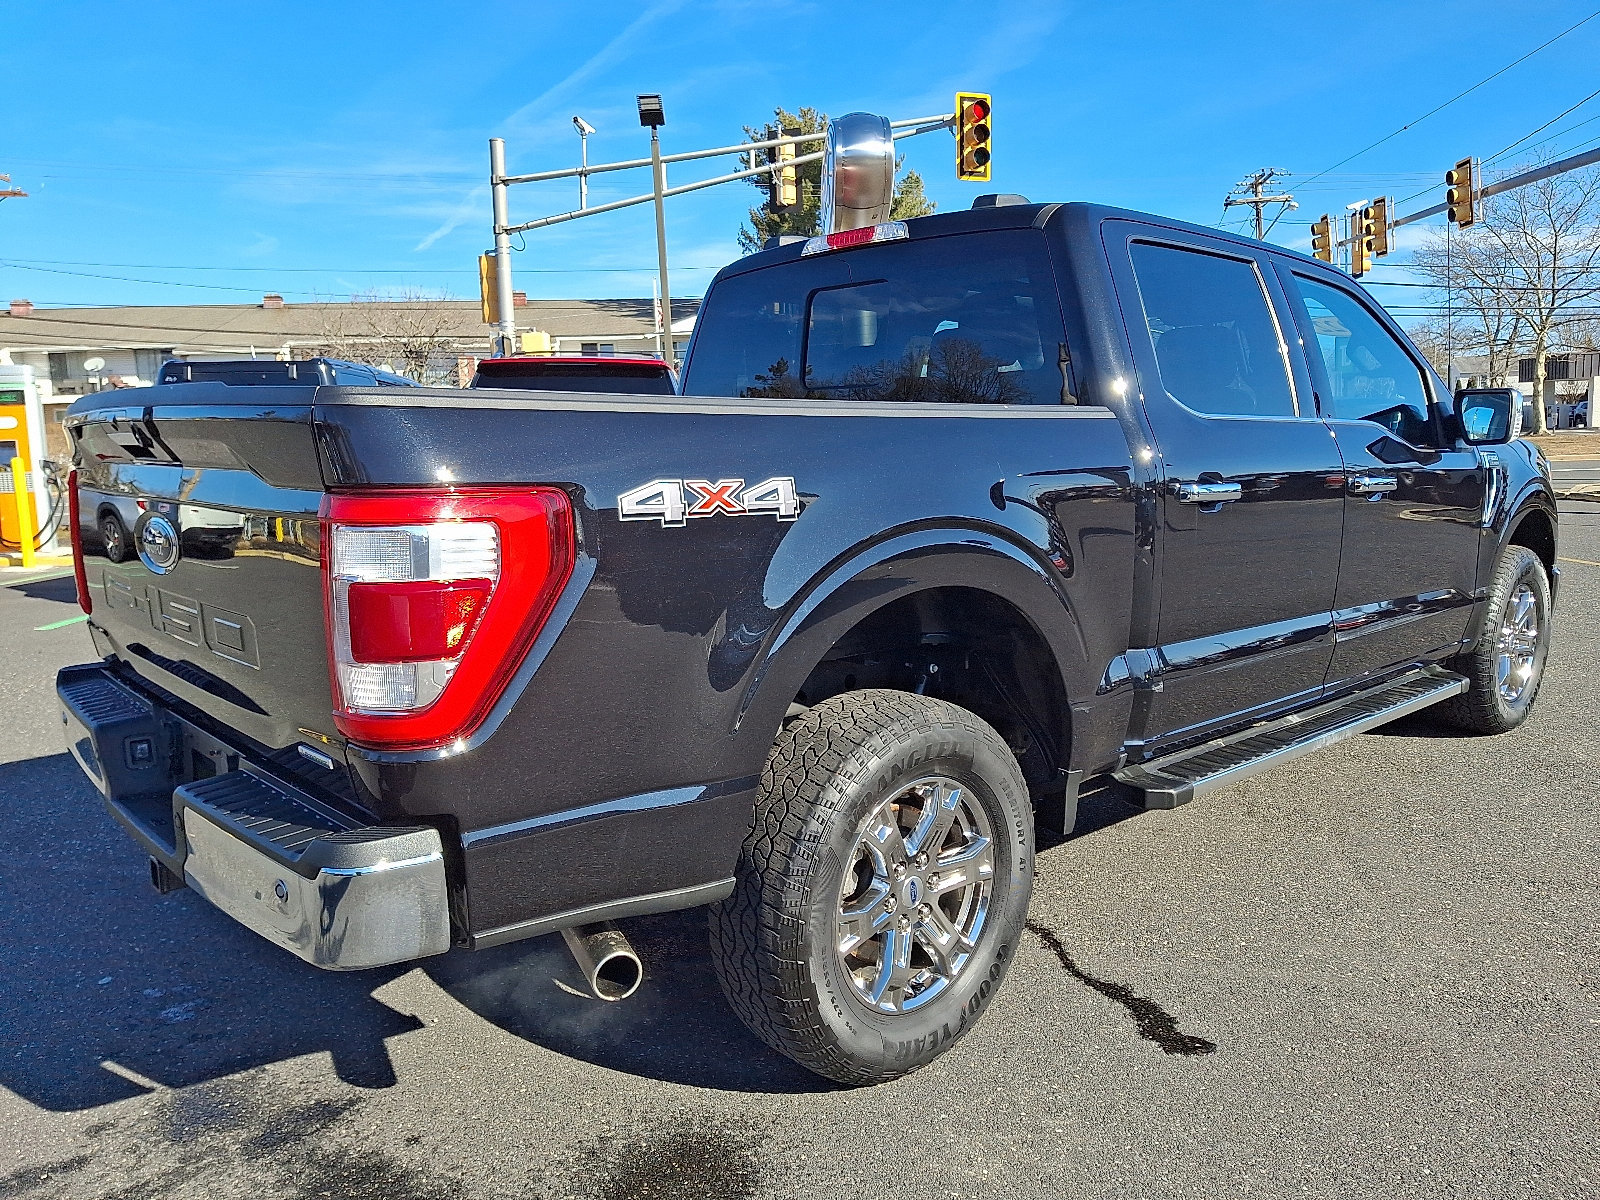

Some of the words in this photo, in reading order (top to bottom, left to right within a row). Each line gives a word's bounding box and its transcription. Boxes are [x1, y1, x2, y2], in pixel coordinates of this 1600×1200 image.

[102, 568, 261, 671] F-150
[839, 742, 963, 844] WRANGLER
[998, 776, 1026, 847] TERRITORY
